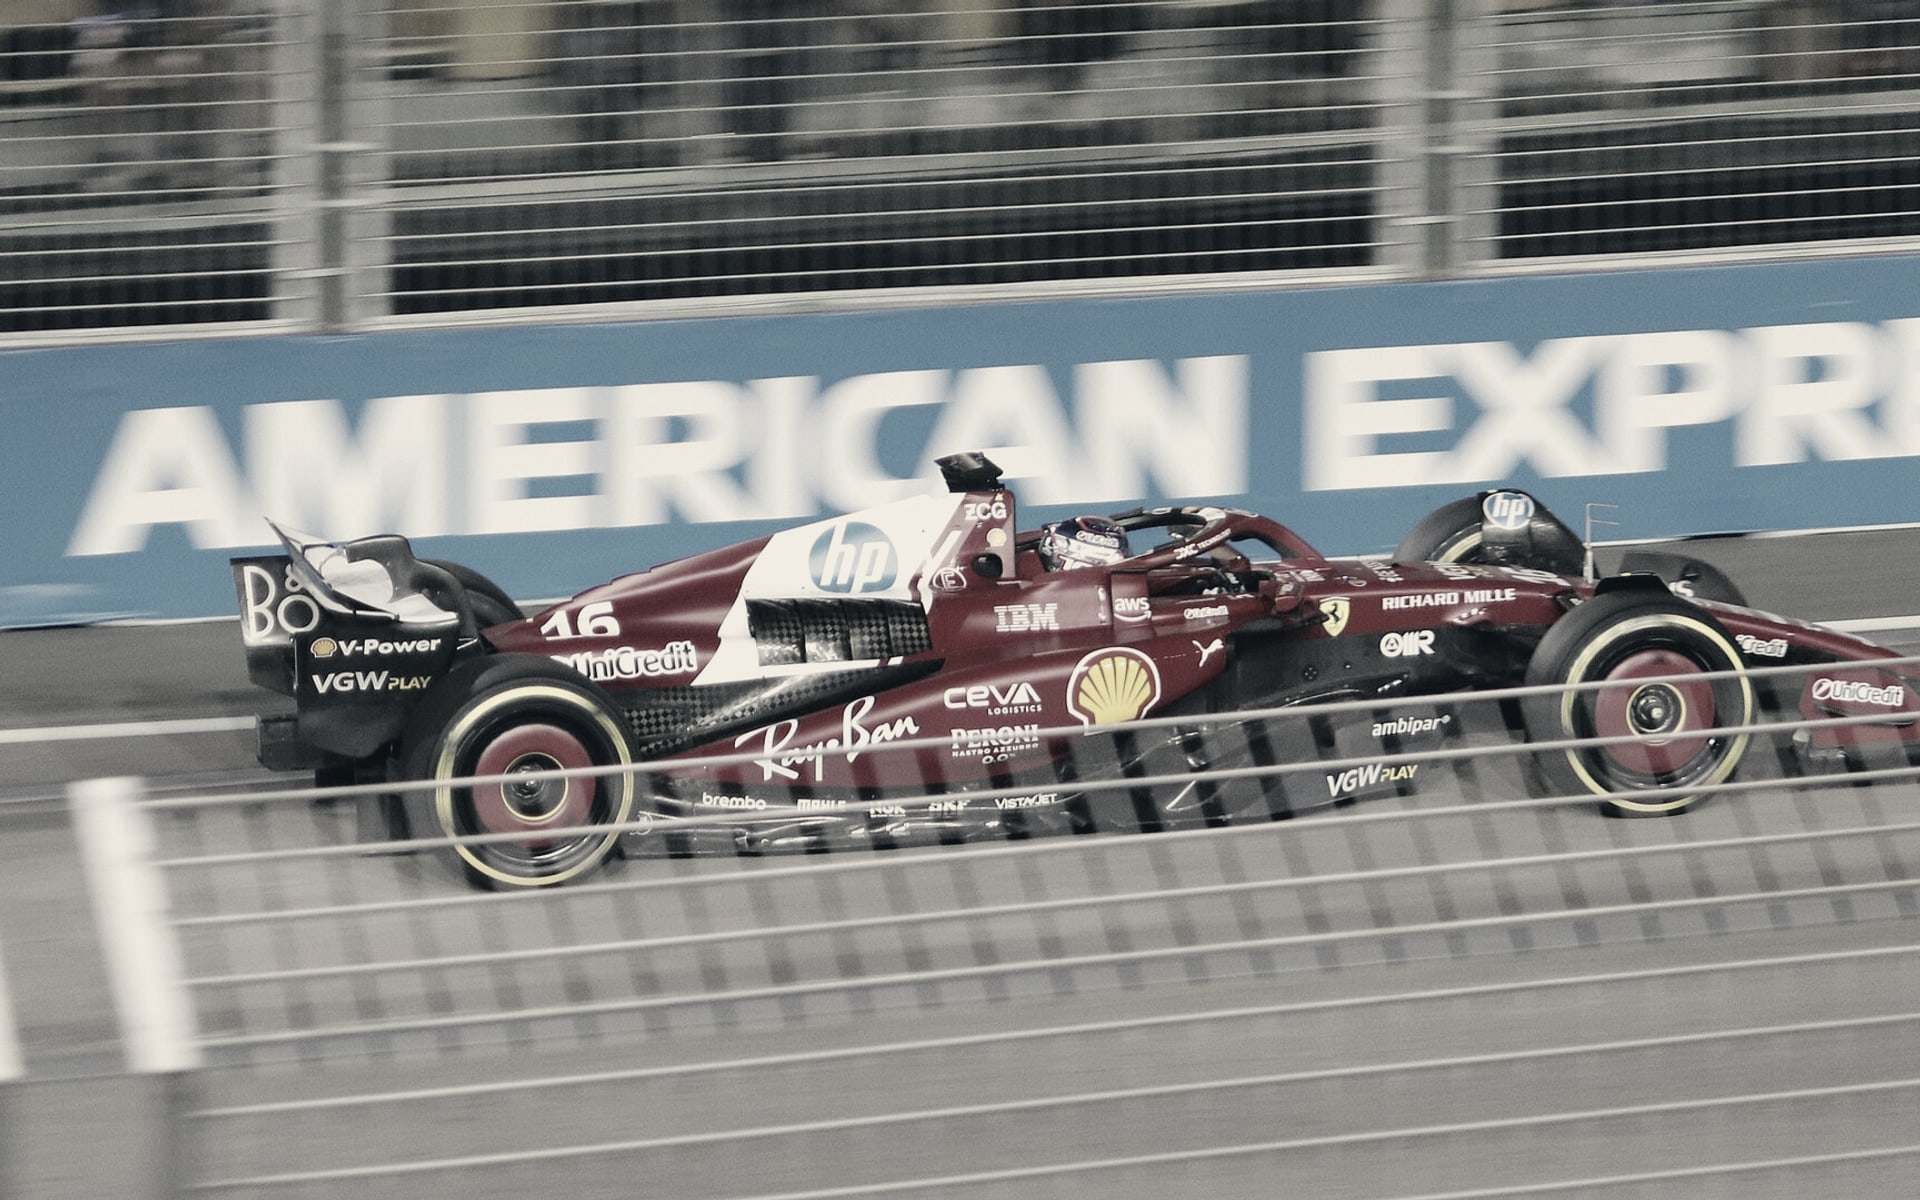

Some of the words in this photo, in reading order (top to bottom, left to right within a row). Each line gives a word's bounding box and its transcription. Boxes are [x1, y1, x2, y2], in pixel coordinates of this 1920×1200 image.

[66, 354, 1250, 556] AMERICAN
[965, 503, 1007, 520] ZCG
[1492, 496, 1526, 527] hp
[820, 525, 890, 592] hp
[1115, 597, 1150, 611] aws
[1382, 595, 1458, 610] RICHARD
[1464, 588, 1516, 604] MILLE
[540, 601, 620, 641] 16
[994, 603, 1059, 632] IBM
[338, 638, 441, 655] V-Power
[573, 641, 696, 680] UniCredit
[311, 671, 389, 694] VGW
[387, 675, 431, 690] PLAY
[1832, 681, 1903, 706] UniCredit
[987, 704, 1042, 716] LOGISTICS
[951, 724, 1039, 749] PERONI
[1372, 716, 1441, 737] ambipar
[1327, 763, 1382, 797] VGW
[1379, 764, 1418, 781] PLAY
[702, 792, 766, 810] brembo
